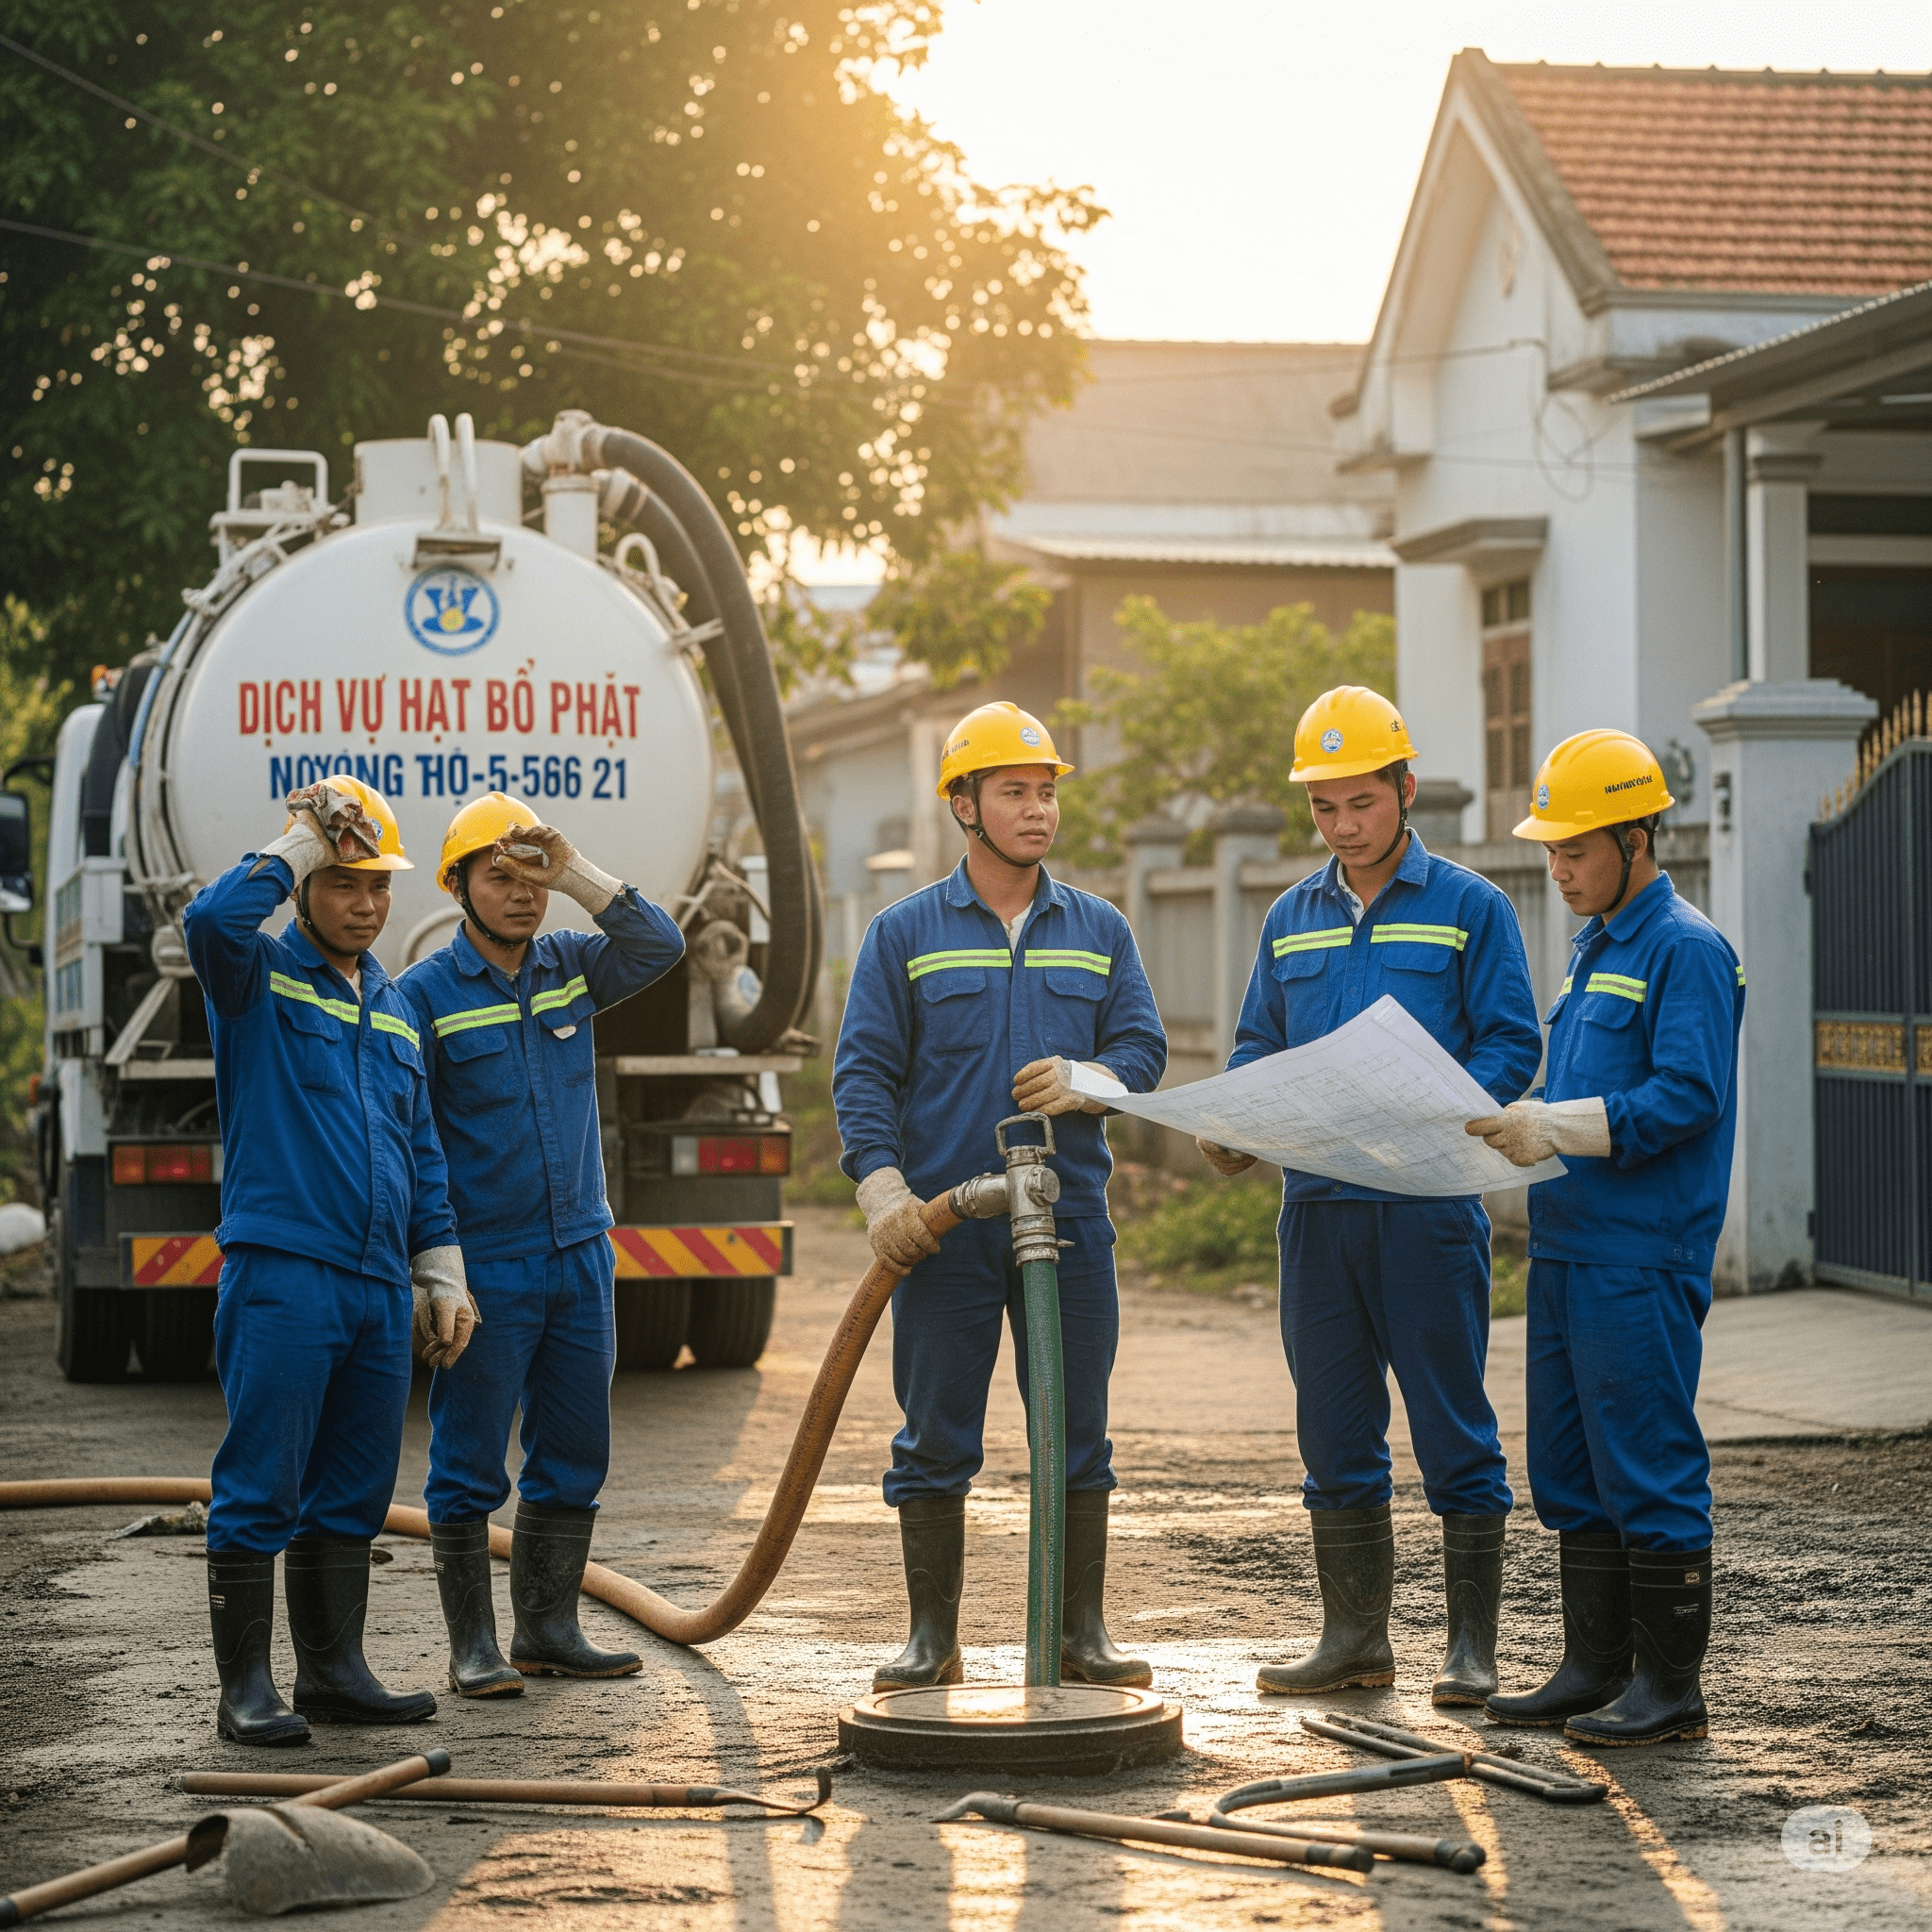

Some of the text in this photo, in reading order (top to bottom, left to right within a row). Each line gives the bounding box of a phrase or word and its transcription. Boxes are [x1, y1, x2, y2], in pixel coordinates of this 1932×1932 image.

[240, 679, 322, 747] DỊCH
[400, 678, 471, 742] HẠT
[486, 658, 535, 734] BỔ
[592, 758, 626, 799] 21
